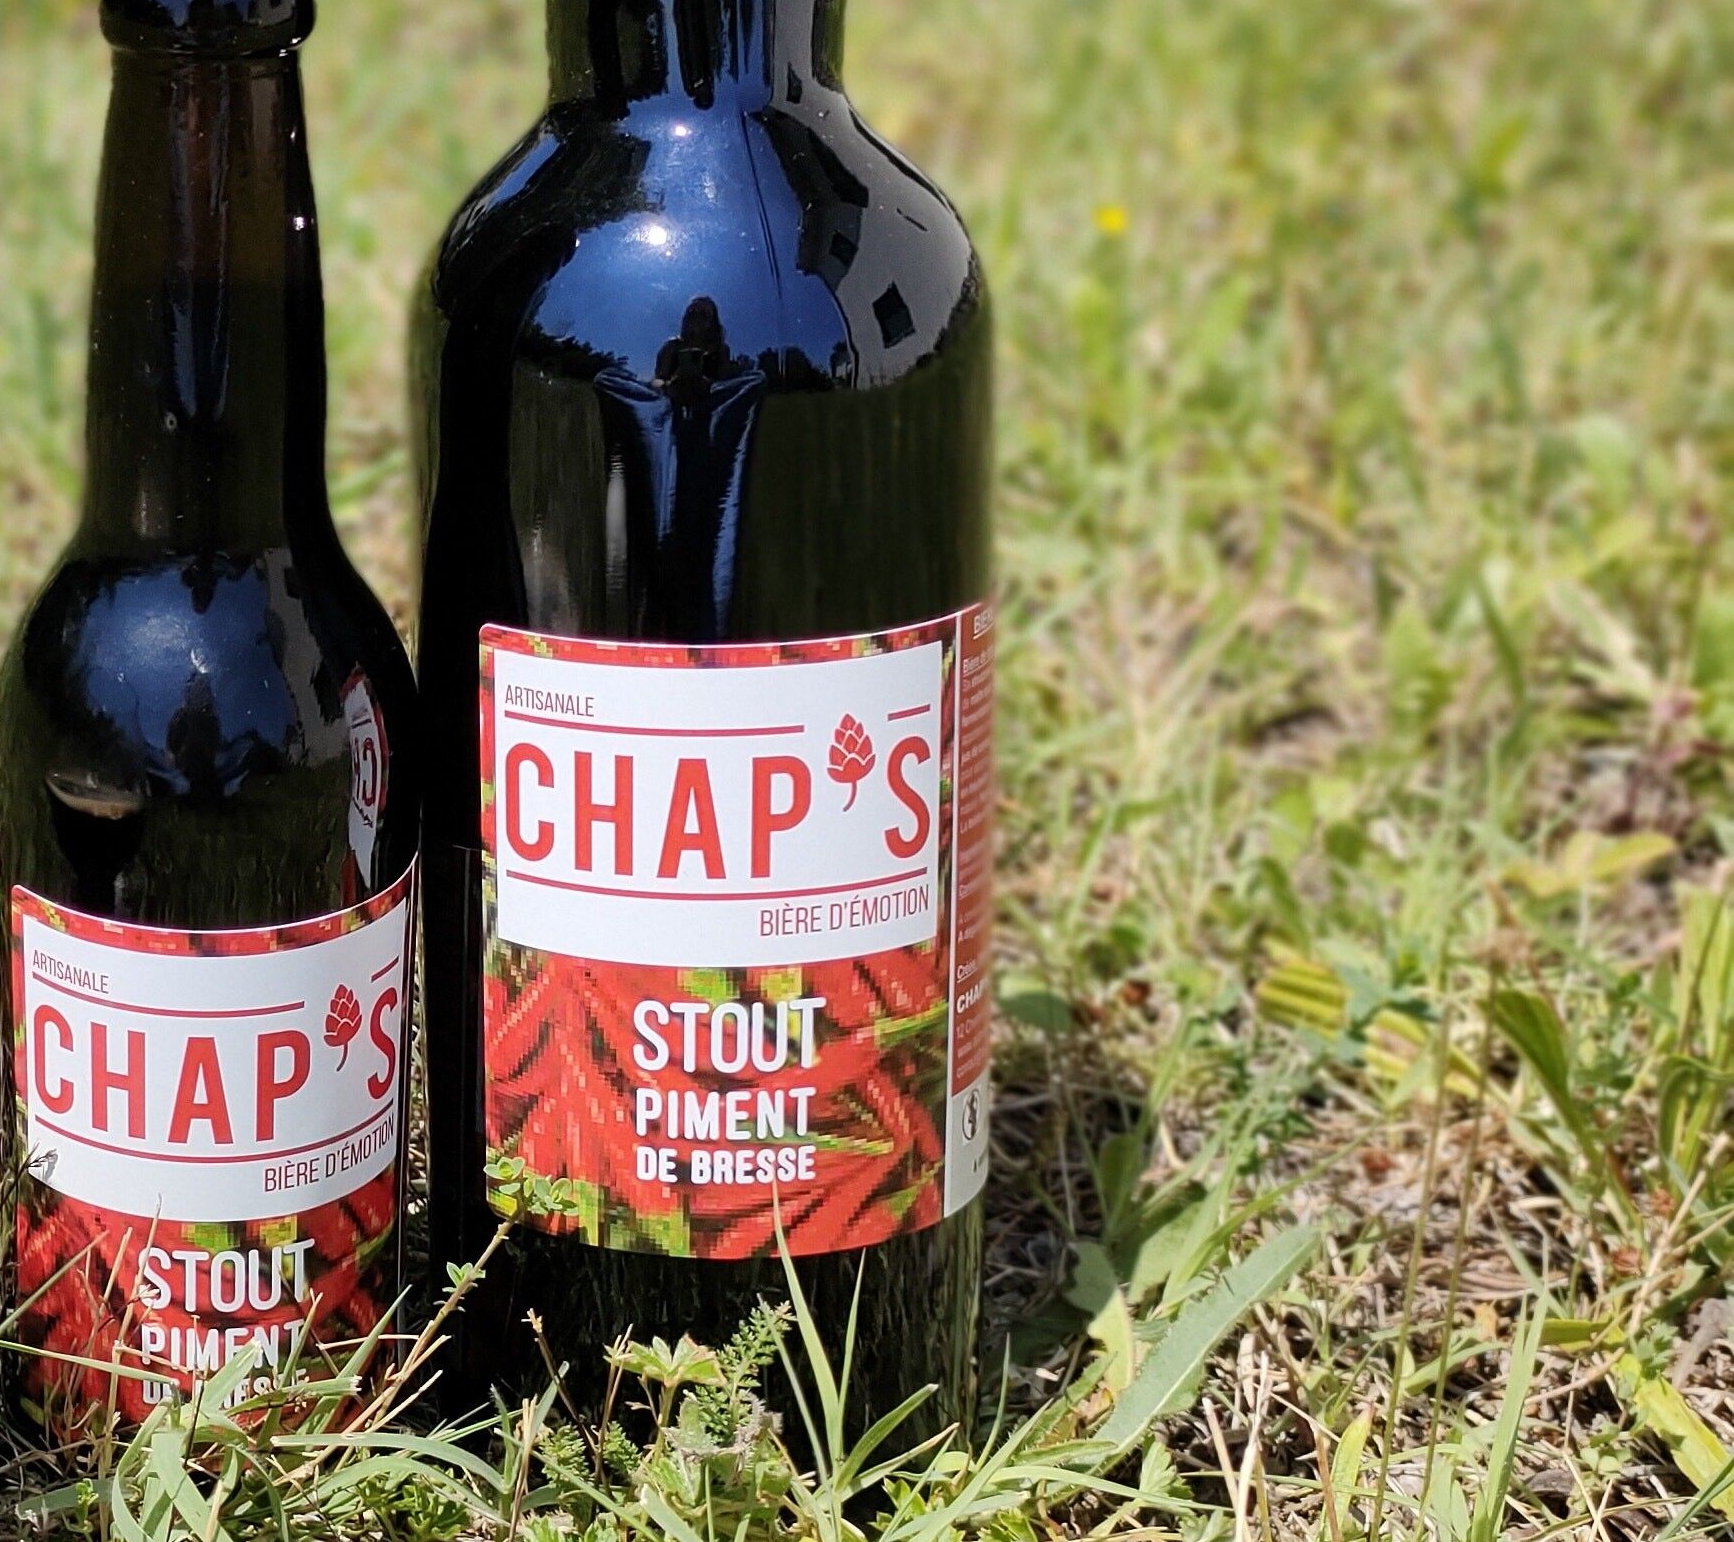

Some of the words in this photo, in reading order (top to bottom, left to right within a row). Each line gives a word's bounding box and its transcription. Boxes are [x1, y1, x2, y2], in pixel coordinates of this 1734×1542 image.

[504, 684, 595, 717] ARTISANALE
[760, 902, 822, 937] BIÈRE
[829, 884, 929, 931] D'ÉMOTION
[32, 948, 110, 995] ARTISANALE
[633, 997, 827, 1073] STOUT
[635, 1086, 816, 1141] PIMENT
[264, 1157, 320, 1193] BIÈRE
[325, 1112, 394, 1178] D'ÉMOTION
[635, 1146, 676, 1182] DE
[690, 1145, 816, 1185] BRESSE
[138, 1237, 315, 1313] STOUT
